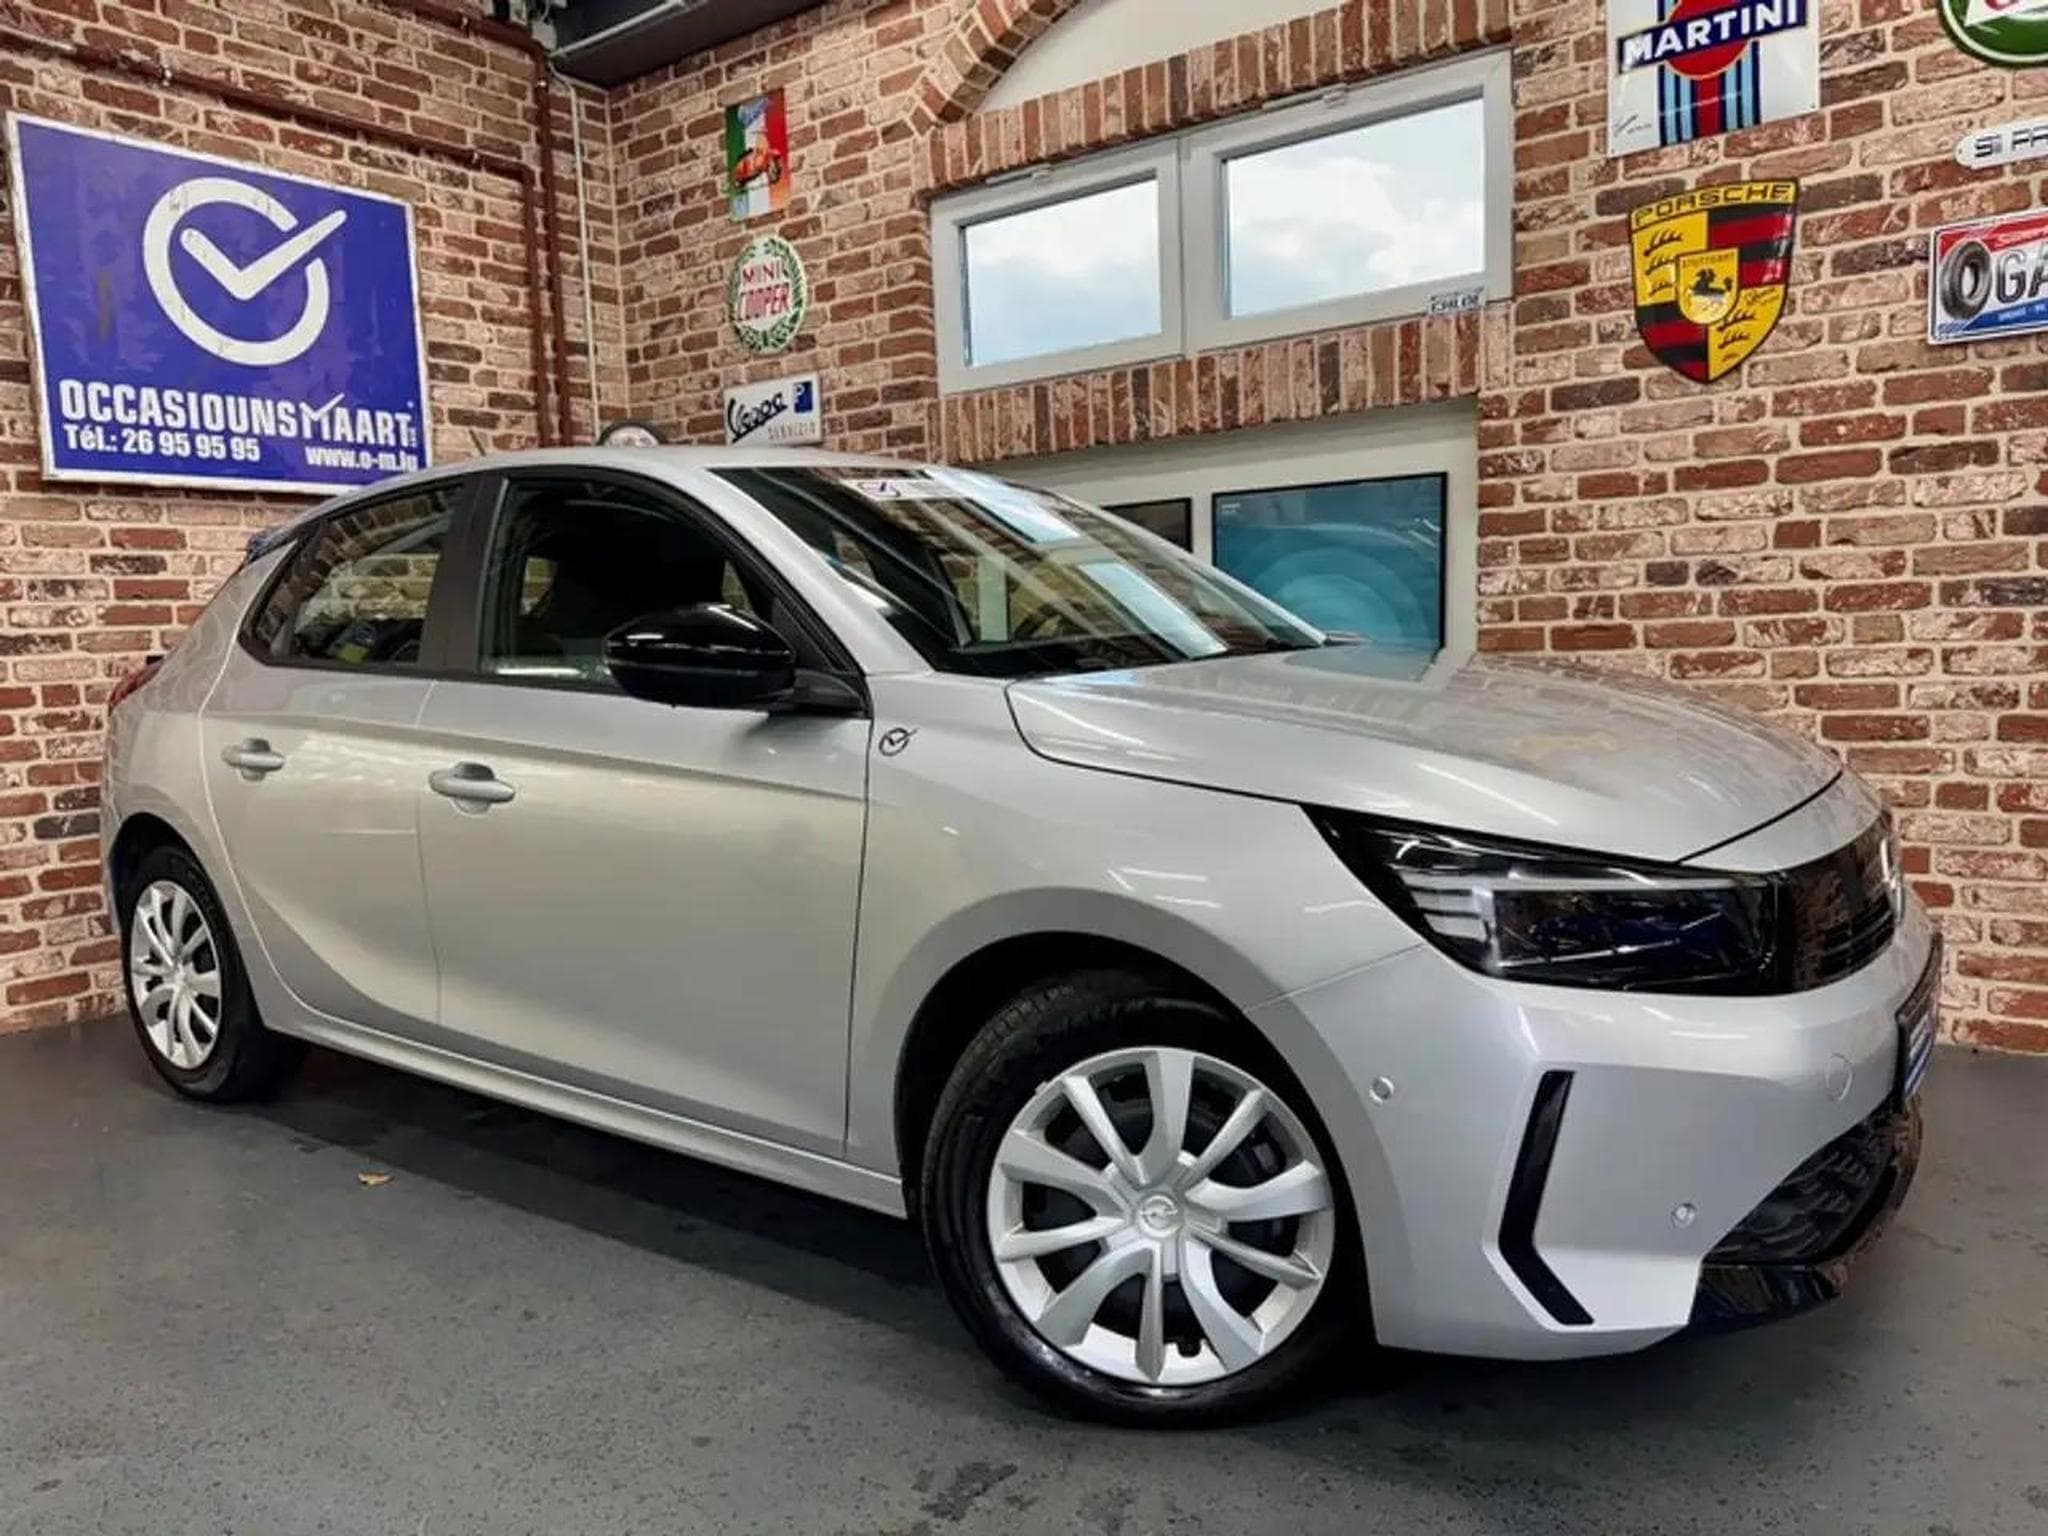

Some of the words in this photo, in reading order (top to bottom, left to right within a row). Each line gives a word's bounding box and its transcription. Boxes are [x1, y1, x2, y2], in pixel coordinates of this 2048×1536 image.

[1622, 0, 1798, 72] MARTINI
[1635, 184, 1791, 227] PORSCHE
[743, 260, 785, 285] MINI
[122, 427, 154, 455] 26
[159, 431, 191, 458] 95
[195, 435, 227, 461] 95
[231, 438, 261, 463] 95
